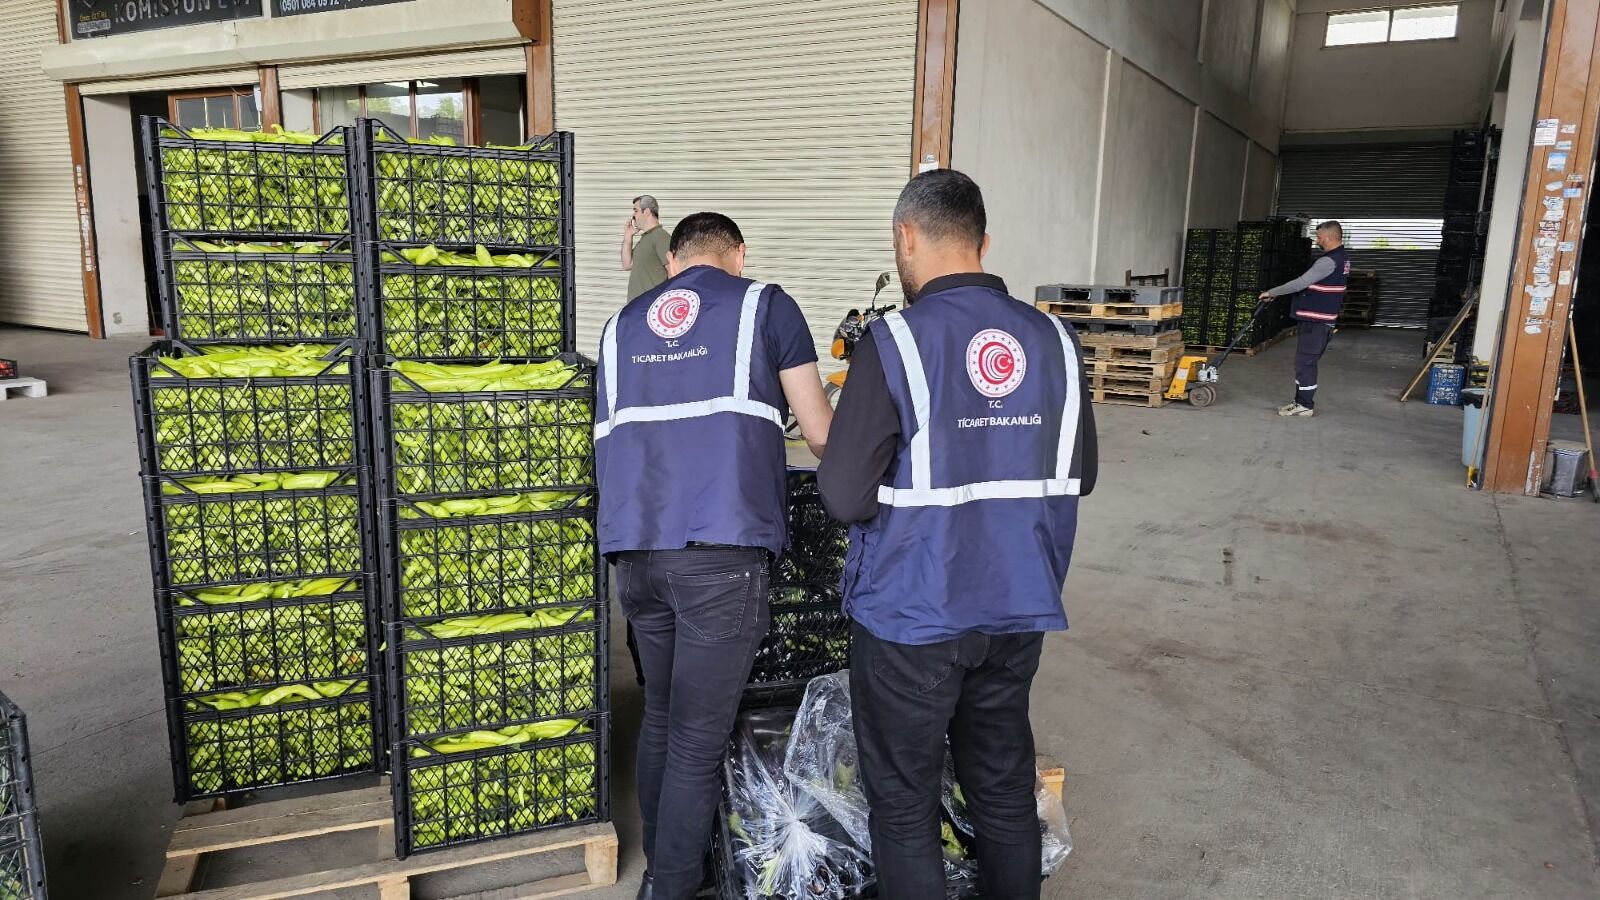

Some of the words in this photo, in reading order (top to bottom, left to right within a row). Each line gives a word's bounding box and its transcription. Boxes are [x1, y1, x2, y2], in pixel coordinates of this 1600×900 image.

[988, 400, 1003, 409] T.C.
[957, 417, 989, 428] TİCARET
[989, 413, 1041, 426] BAKANLIĞI
